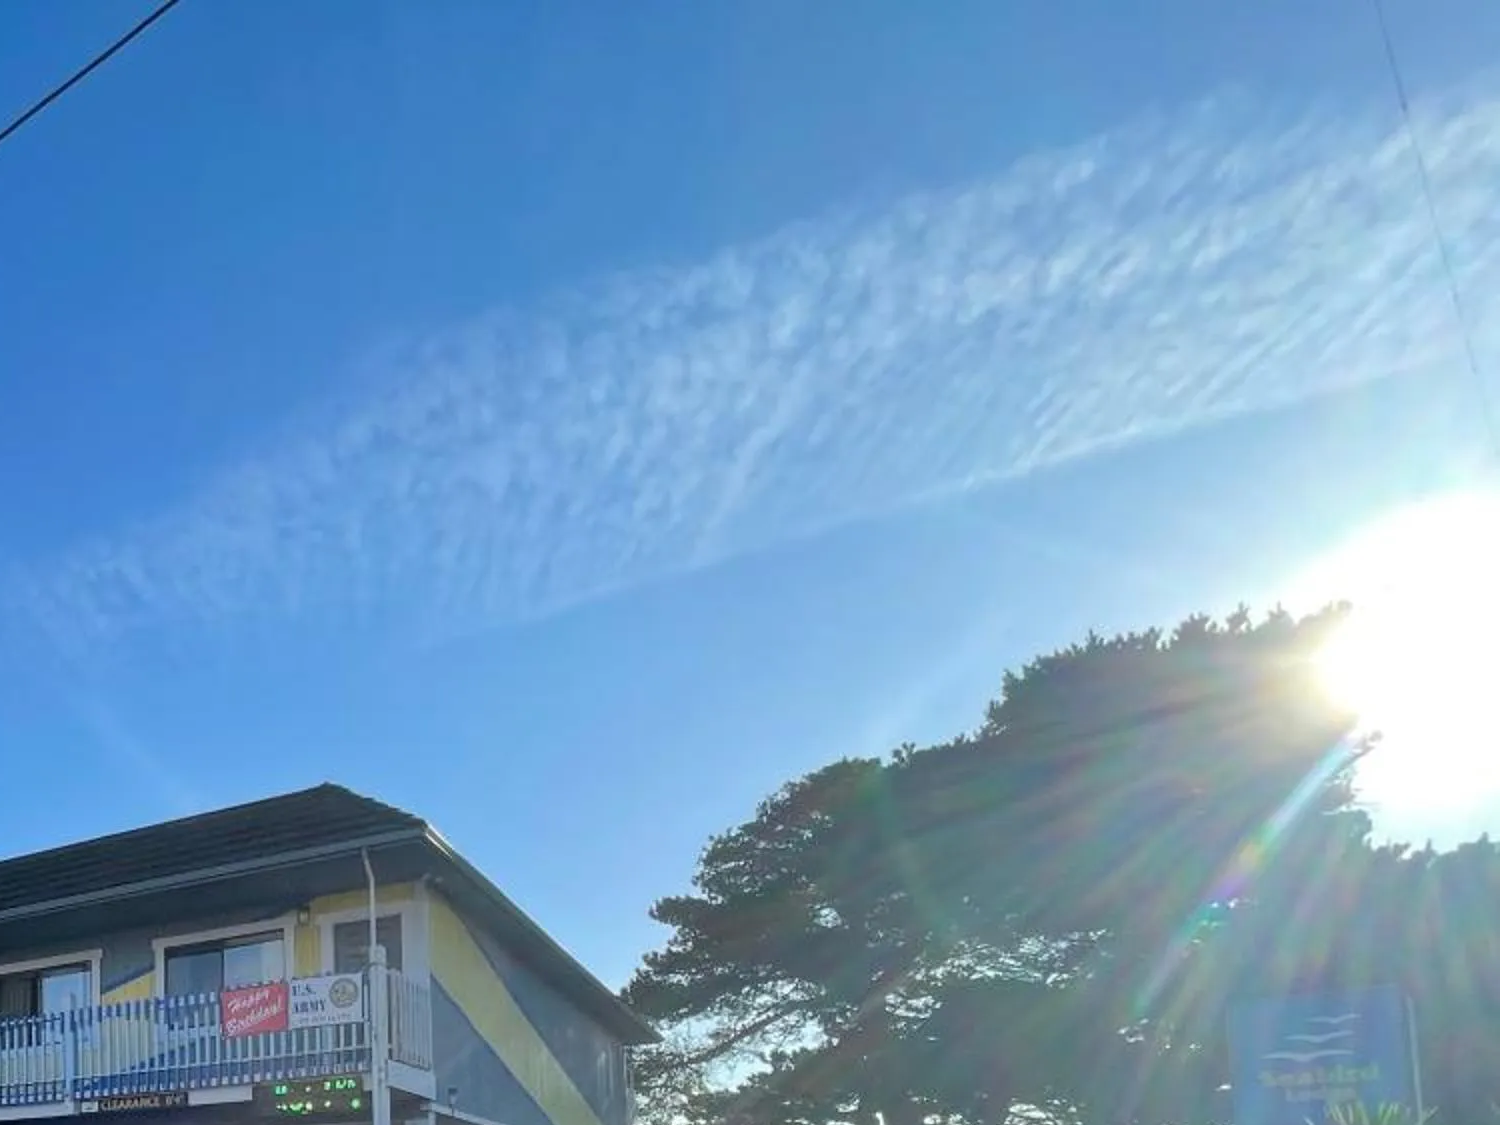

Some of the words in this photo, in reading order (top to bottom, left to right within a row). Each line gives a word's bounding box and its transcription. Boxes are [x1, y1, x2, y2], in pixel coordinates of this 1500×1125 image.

[227, 987, 269, 1013] Happy
[291, 998, 327, 1014] ARMY
[225, 997, 282, 1037] Birthday!
[101, 1096, 160, 1111] CLEARANCE
